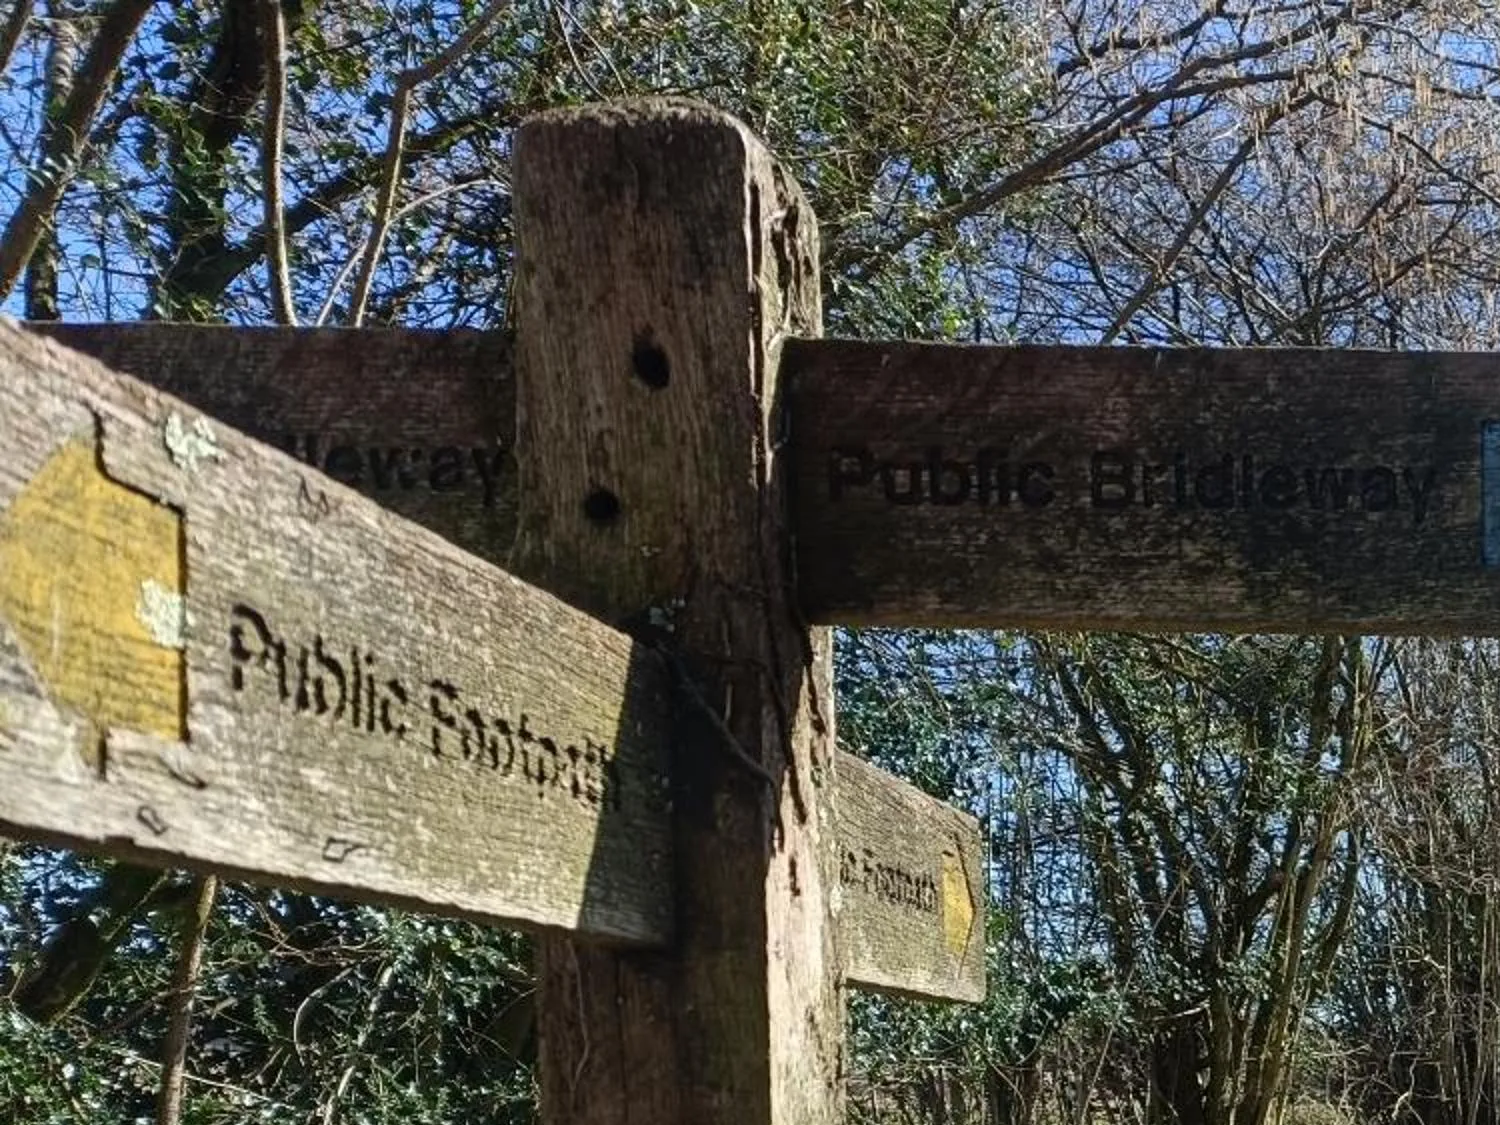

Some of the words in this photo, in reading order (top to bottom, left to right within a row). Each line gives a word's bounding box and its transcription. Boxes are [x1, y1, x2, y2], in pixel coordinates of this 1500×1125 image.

[826, 446, 1056, 510] Public
[1090, 449, 1436, 522] Bridleway
[230, 603, 407, 739] Public
